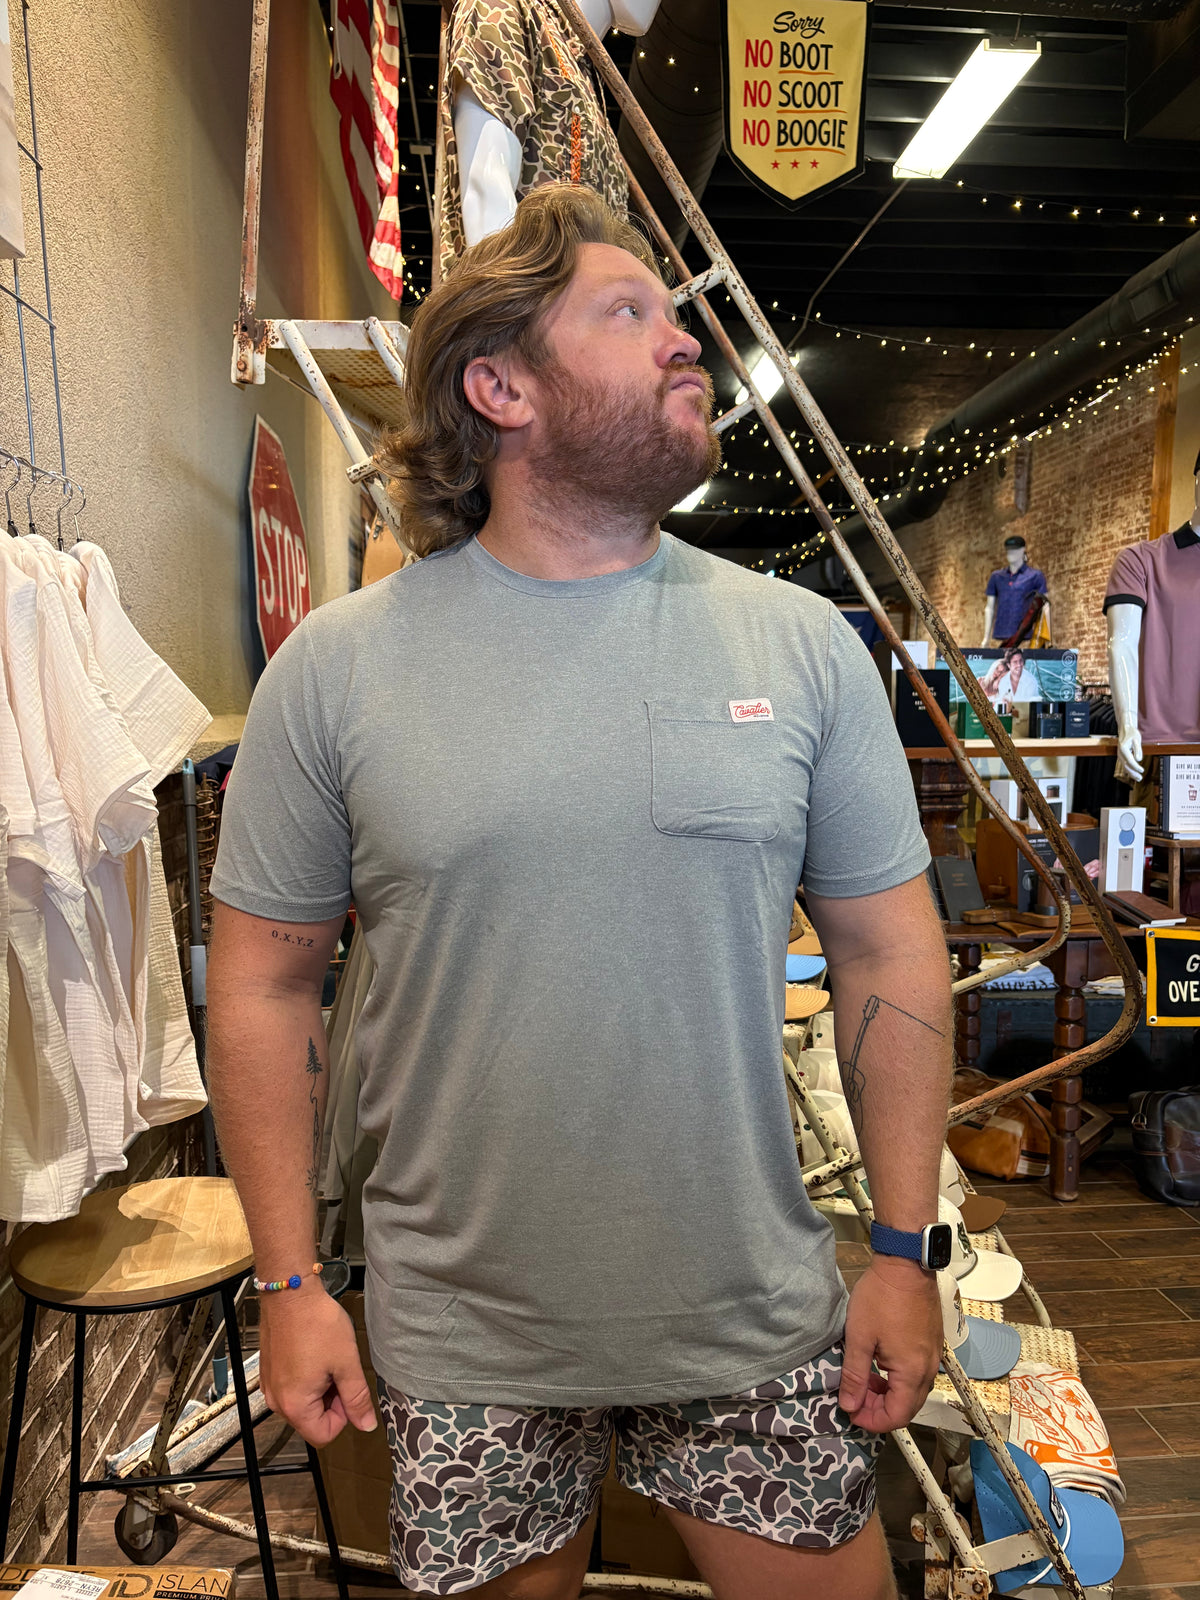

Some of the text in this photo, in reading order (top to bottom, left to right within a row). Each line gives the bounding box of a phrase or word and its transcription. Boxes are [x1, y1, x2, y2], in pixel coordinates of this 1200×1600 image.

[773, 11, 825, 39] Sorry
[745, 39, 833, 70] NO BOOT
[743, 80, 843, 108] NO SCOOT
[743, 119, 848, 149] NO BOOGIE
[259, 507, 306, 624] STOP
[156, 1591, 198, 1600] PREMIUM
